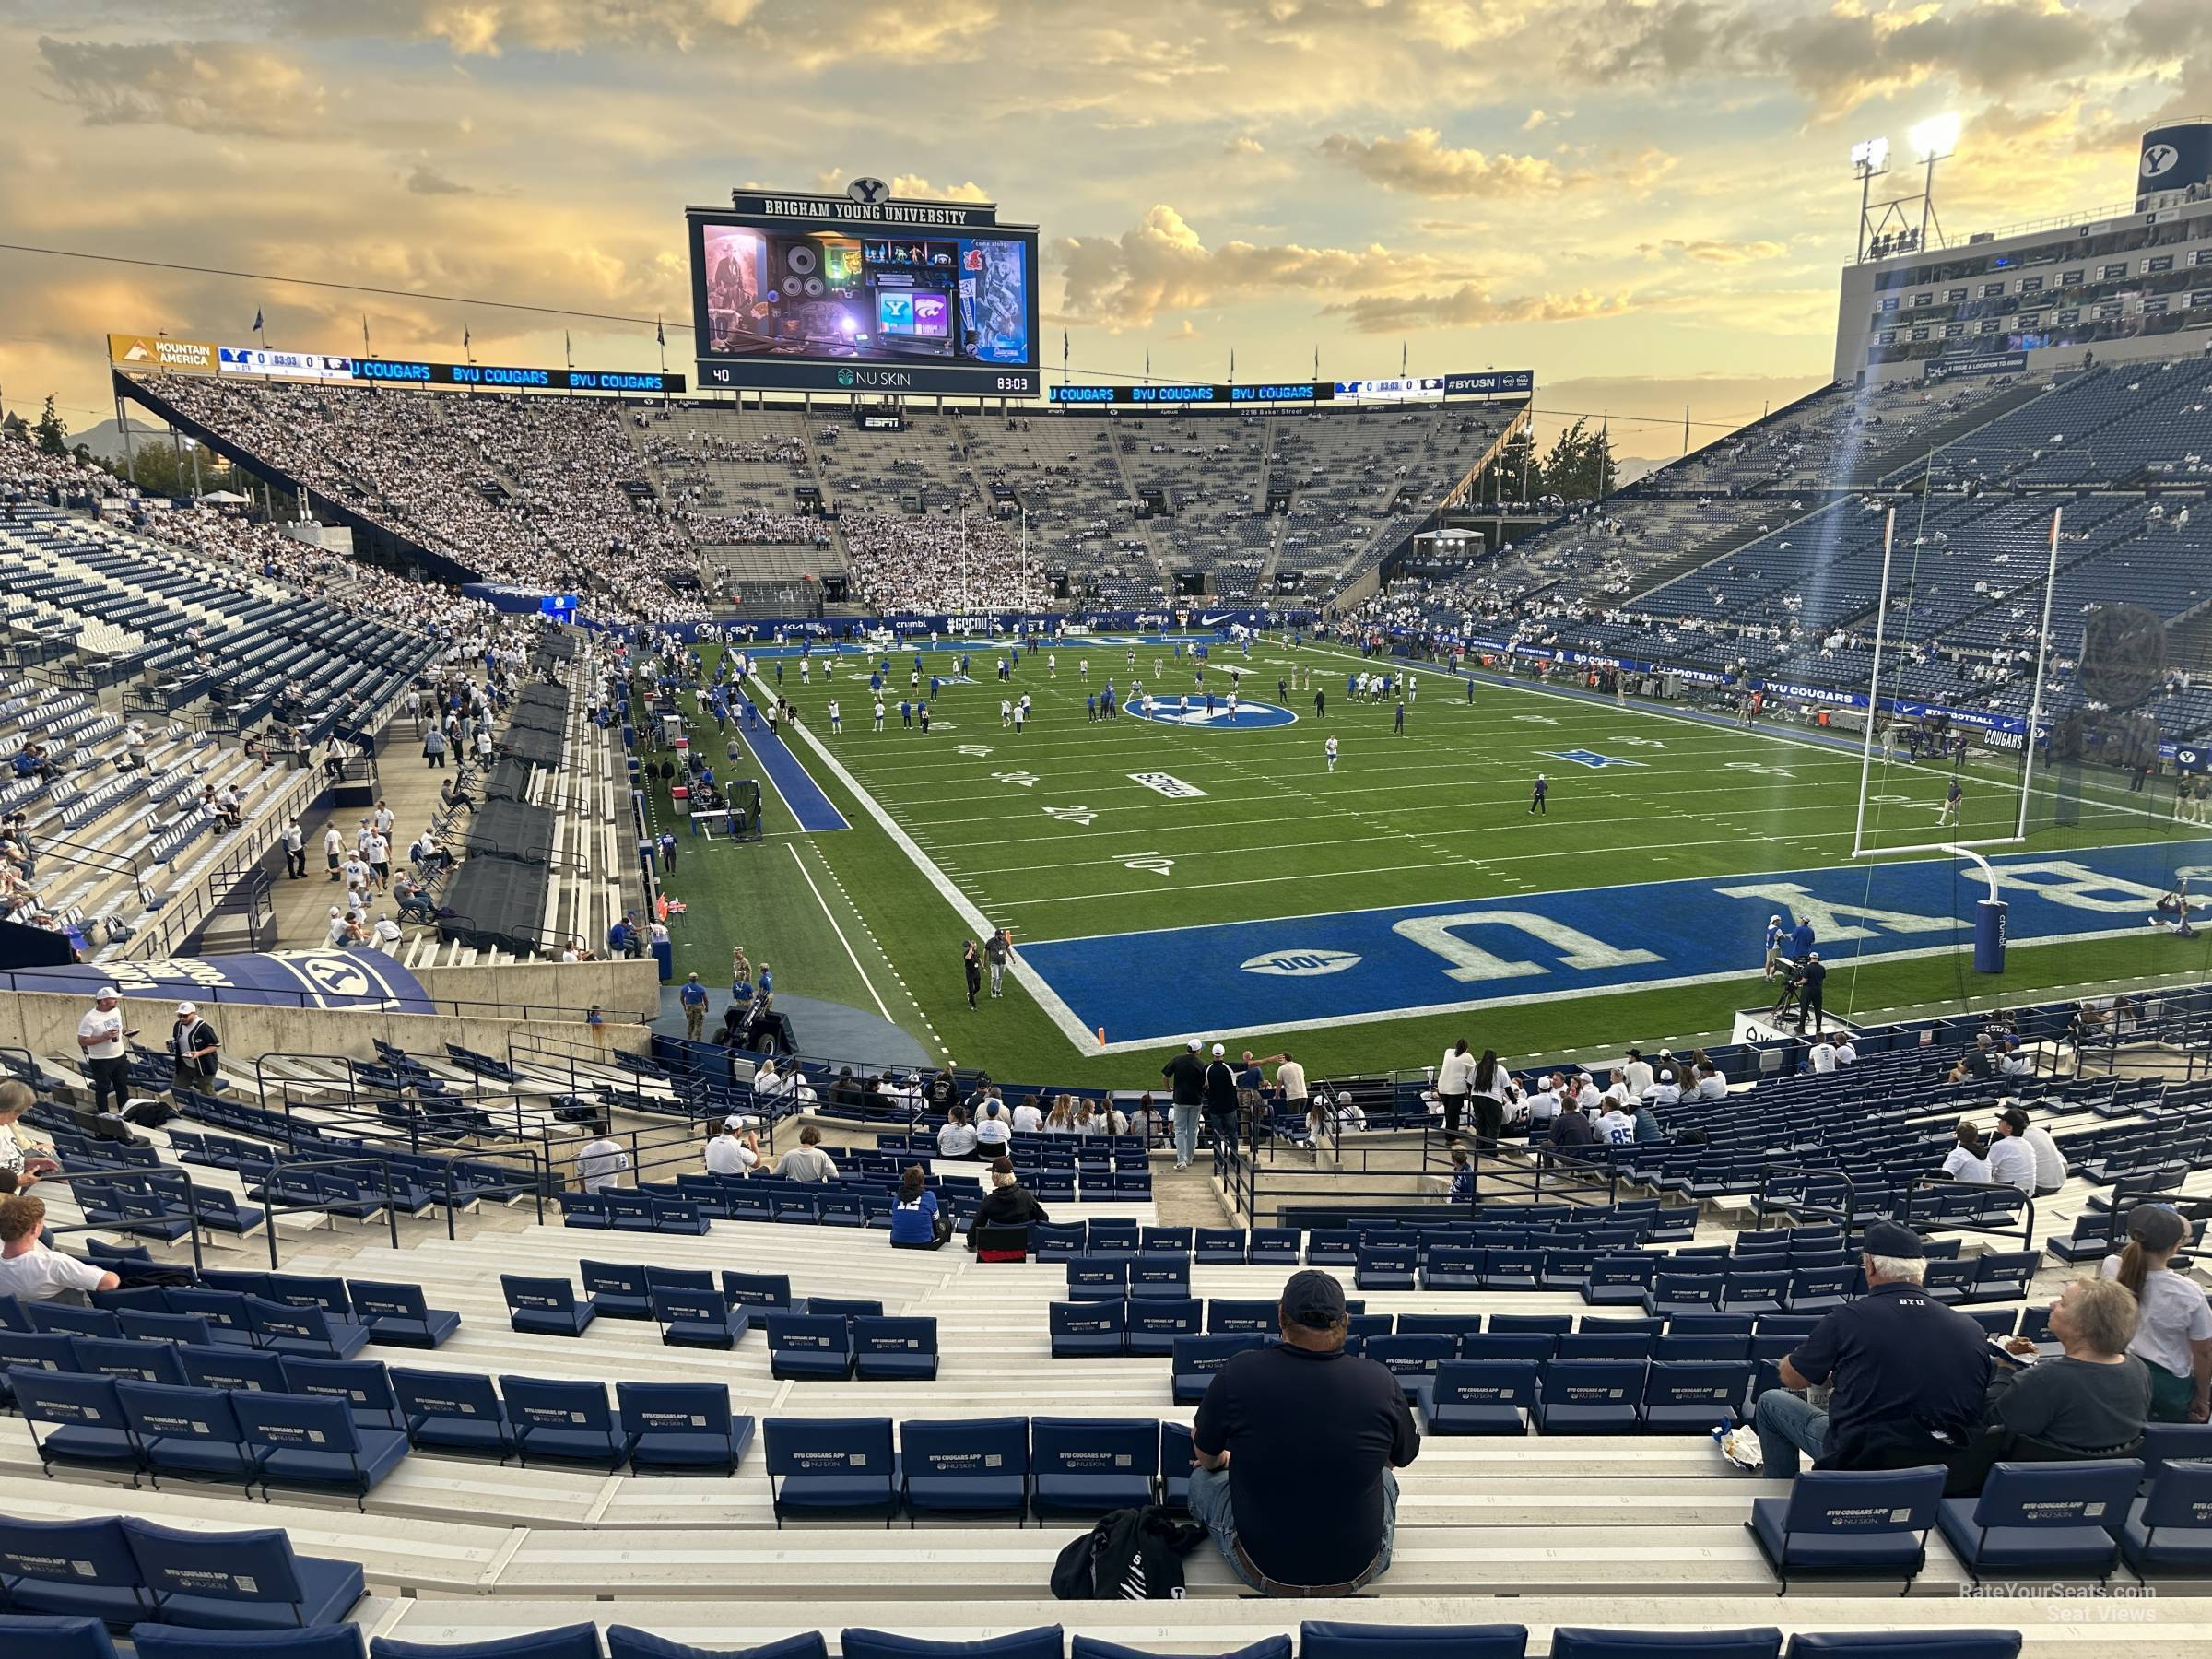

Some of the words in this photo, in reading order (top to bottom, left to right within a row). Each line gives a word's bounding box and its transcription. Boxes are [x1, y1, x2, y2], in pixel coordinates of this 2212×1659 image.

[765, 200, 830, 217] BRIGHAM
[836, 205, 881, 220] YOUNG
[885, 206, 966, 224] UNIVERSITY
[155, 342, 210, 356] MOUNTAIN
[160, 354, 208, 366] AMERICA
[258, 353, 265, 363] 0
[274, 355, 297, 366] 83:03
[306, 357, 313, 368] 0
[364, 363, 430, 379] COUGARS
[453, 368, 479, 382] BYU
[485, 369, 548, 384] COUGARS
[713, 370, 729, 382] 40
[570, 373, 596, 387] BYU
[601, 375, 663, 389] COUGARS
[856, 371, 877, 385] NU
[880, 373, 911, 386] SKIN
[997, 378, 1028, 390] 83:03
[1448, 379, 1495, 389] #BYUSN
[1367, 382, 1371, 391] 0
[1406, 381, 1412, 389] 0
[1060, 389, 1114, 400] COUGARS
[1133, 389, 1155, 400] BYU
[1159, 388, 1214, 400] COUGARS
[1232, 389, 1255, 399] BYU
[1259, 387, 1313, 399] COUGARS
[865, 417, 899, 427] ESPN
[947, 615, 1000, 630] #GOCOUS
[1527, 648, 1550, 656] FOOTBALL
[1573, 653, 1586, 663] GO
[1790, 686, 1853, 703] COUGARS
[1983, 729, 2023, 750] COUGARS
[1041, 805, 1099, 820] 20
[1111, 851, 1175, 869] 10
[1998, 914, 2006, 947] crumbl
[1610, 1127, 1632, 1144] 85
[1900, 1298, 1924, 1306] BYU
